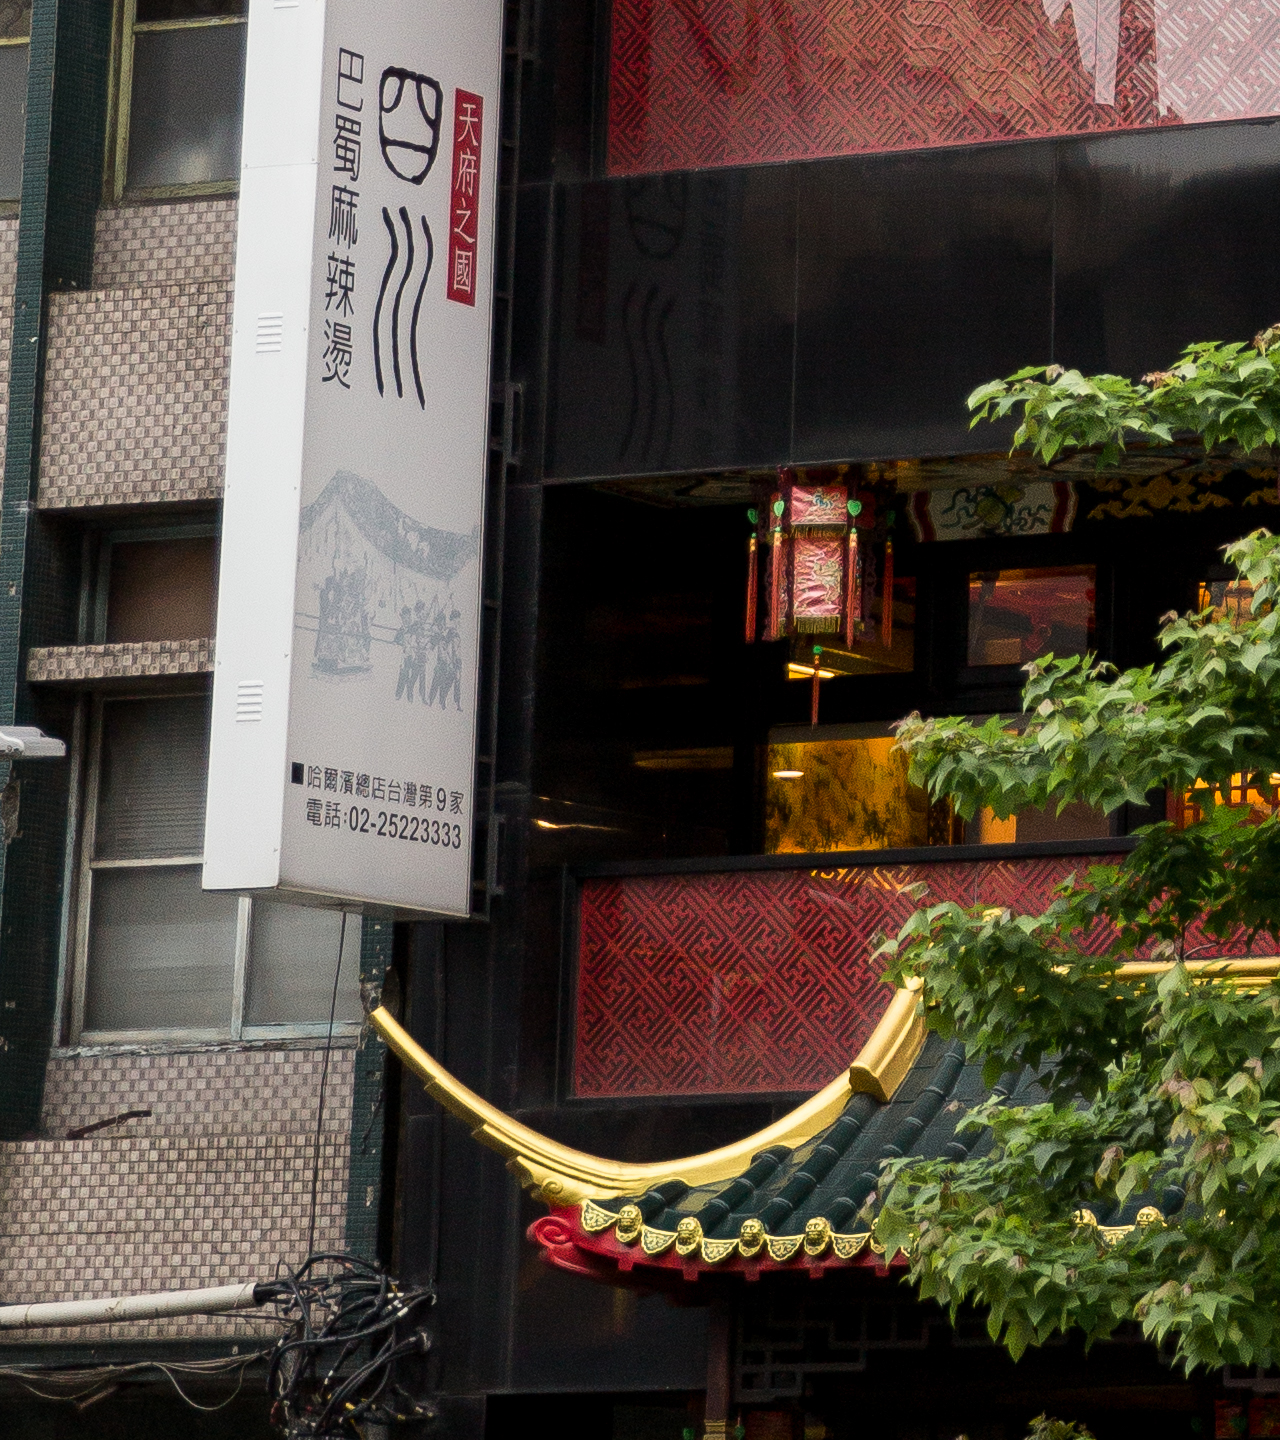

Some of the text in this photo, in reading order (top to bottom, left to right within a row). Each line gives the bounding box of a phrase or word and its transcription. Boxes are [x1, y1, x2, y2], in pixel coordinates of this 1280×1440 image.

[321, 46, 364, 390] 巴蜀麻辣燙
[452, 102, 480, 295] 天府之國
[306, 765, 466, 815] 哈爾濱總店台灣第9家
